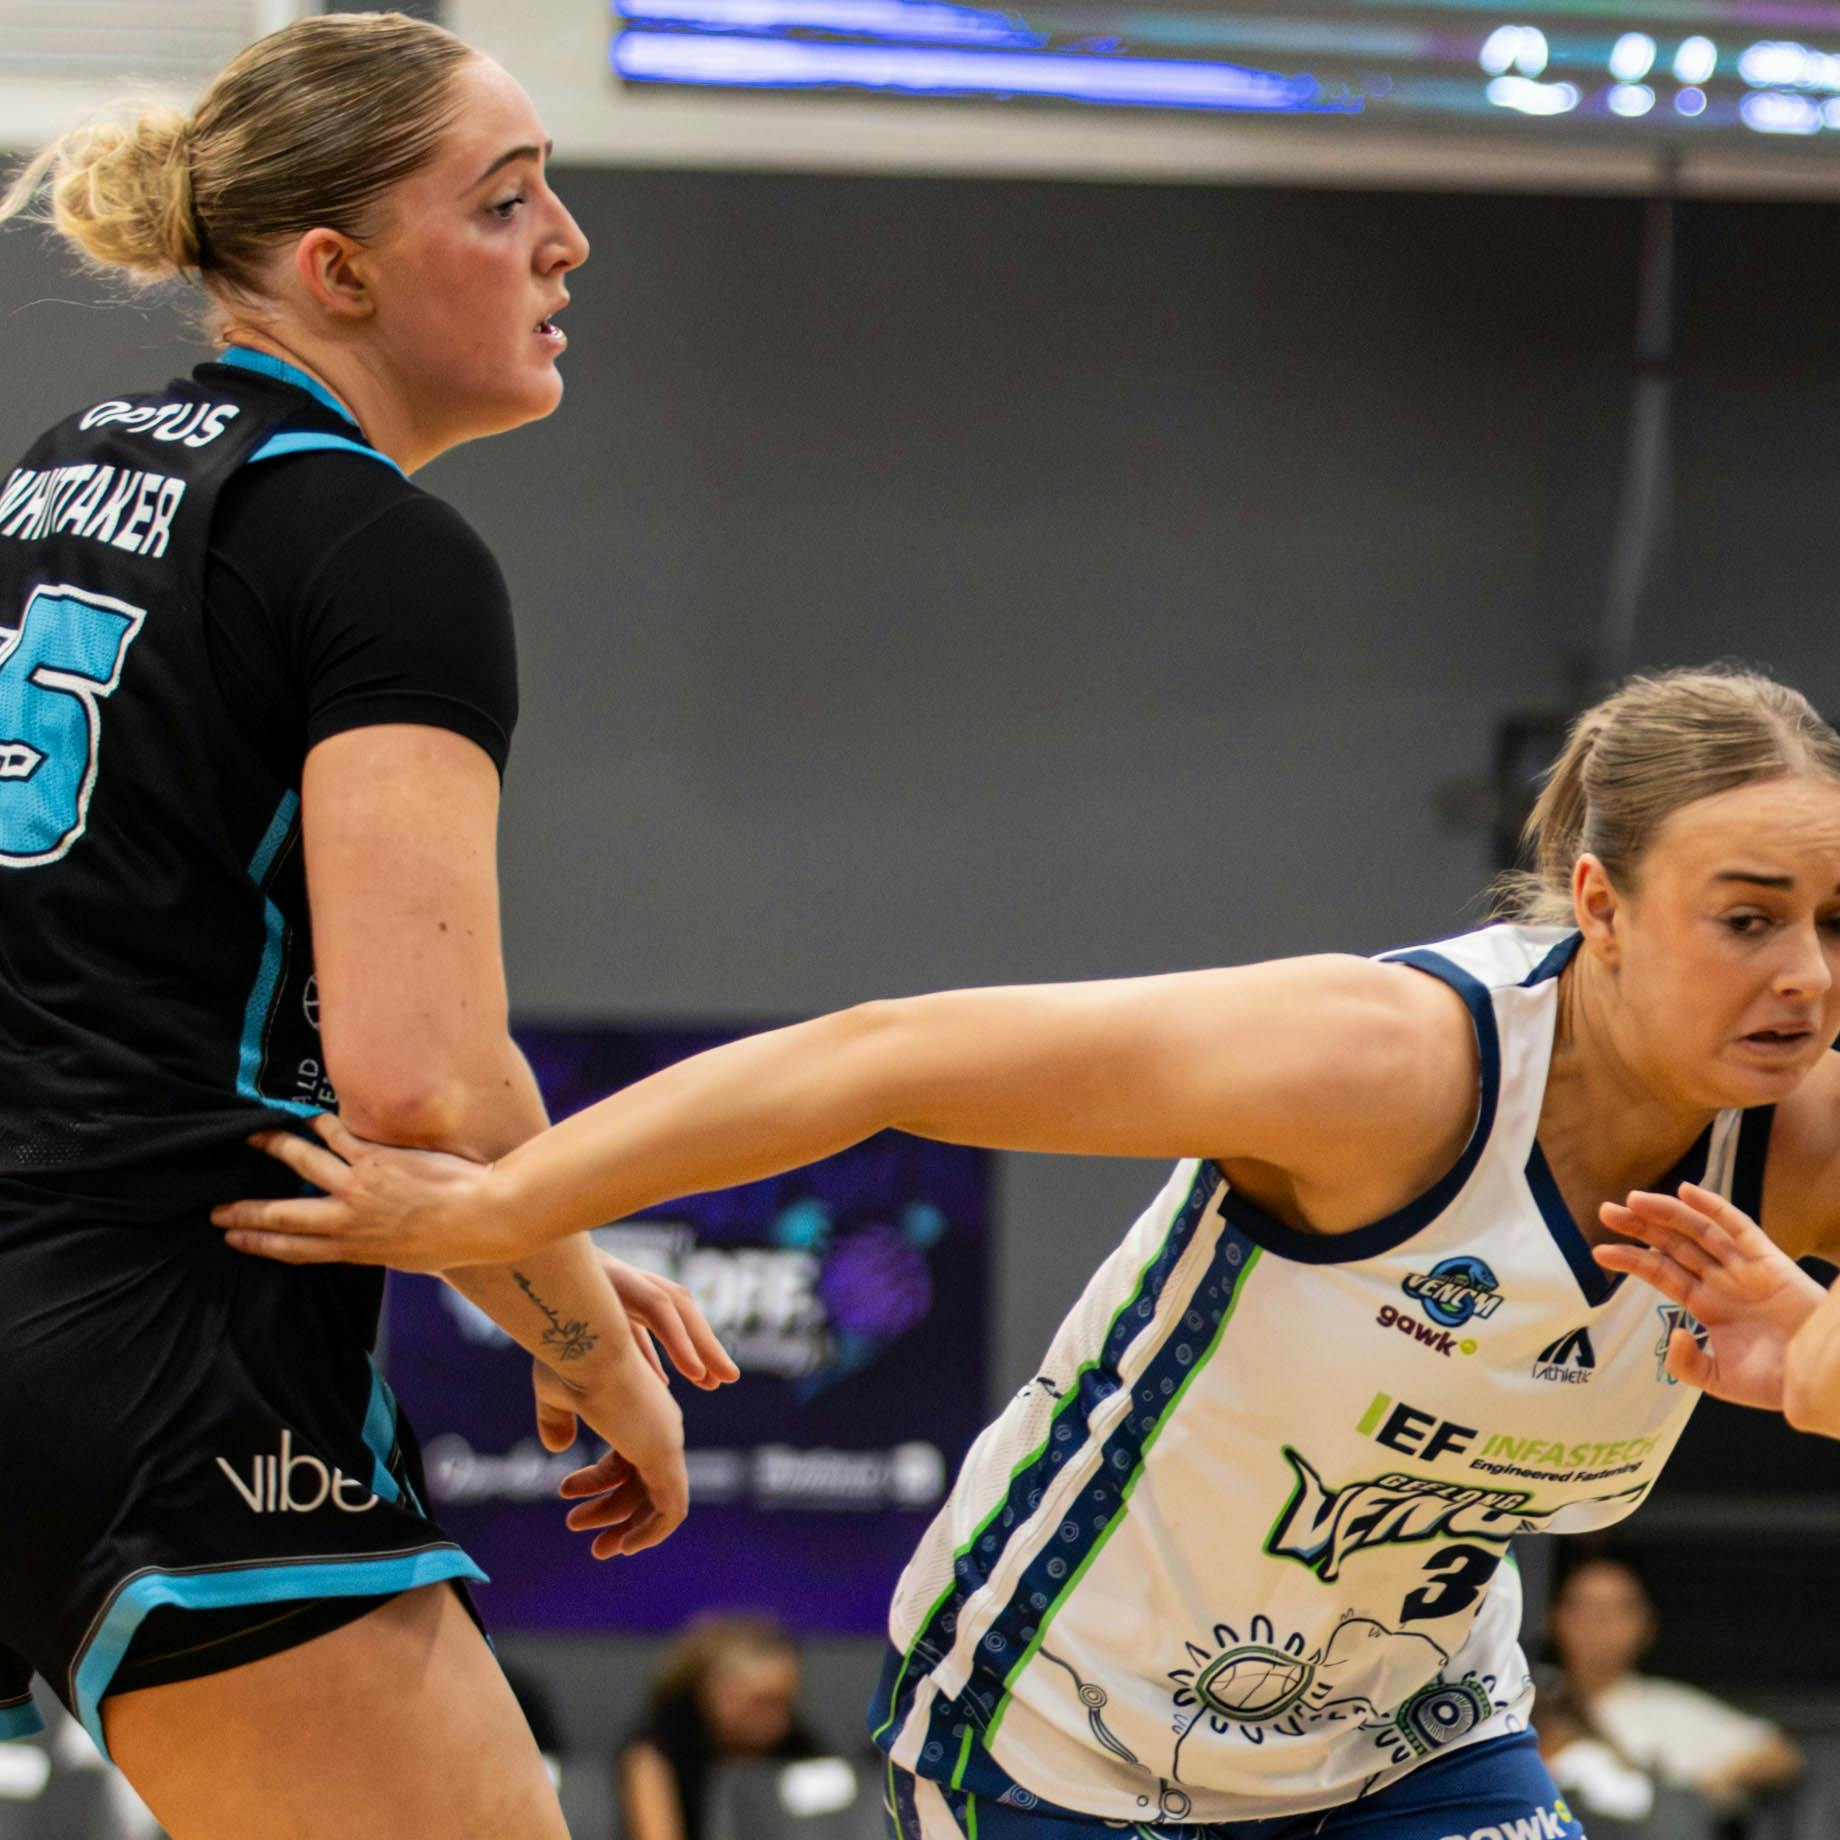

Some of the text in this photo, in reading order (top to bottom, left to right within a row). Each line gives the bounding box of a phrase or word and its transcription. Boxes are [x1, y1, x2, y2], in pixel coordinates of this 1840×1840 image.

[1375, 1303, 1461, 1357] gawk
[1468, 1459, 1643, 1484] Engineered Fastening
[1378, 1473, 1528, 1510] GEELONG
